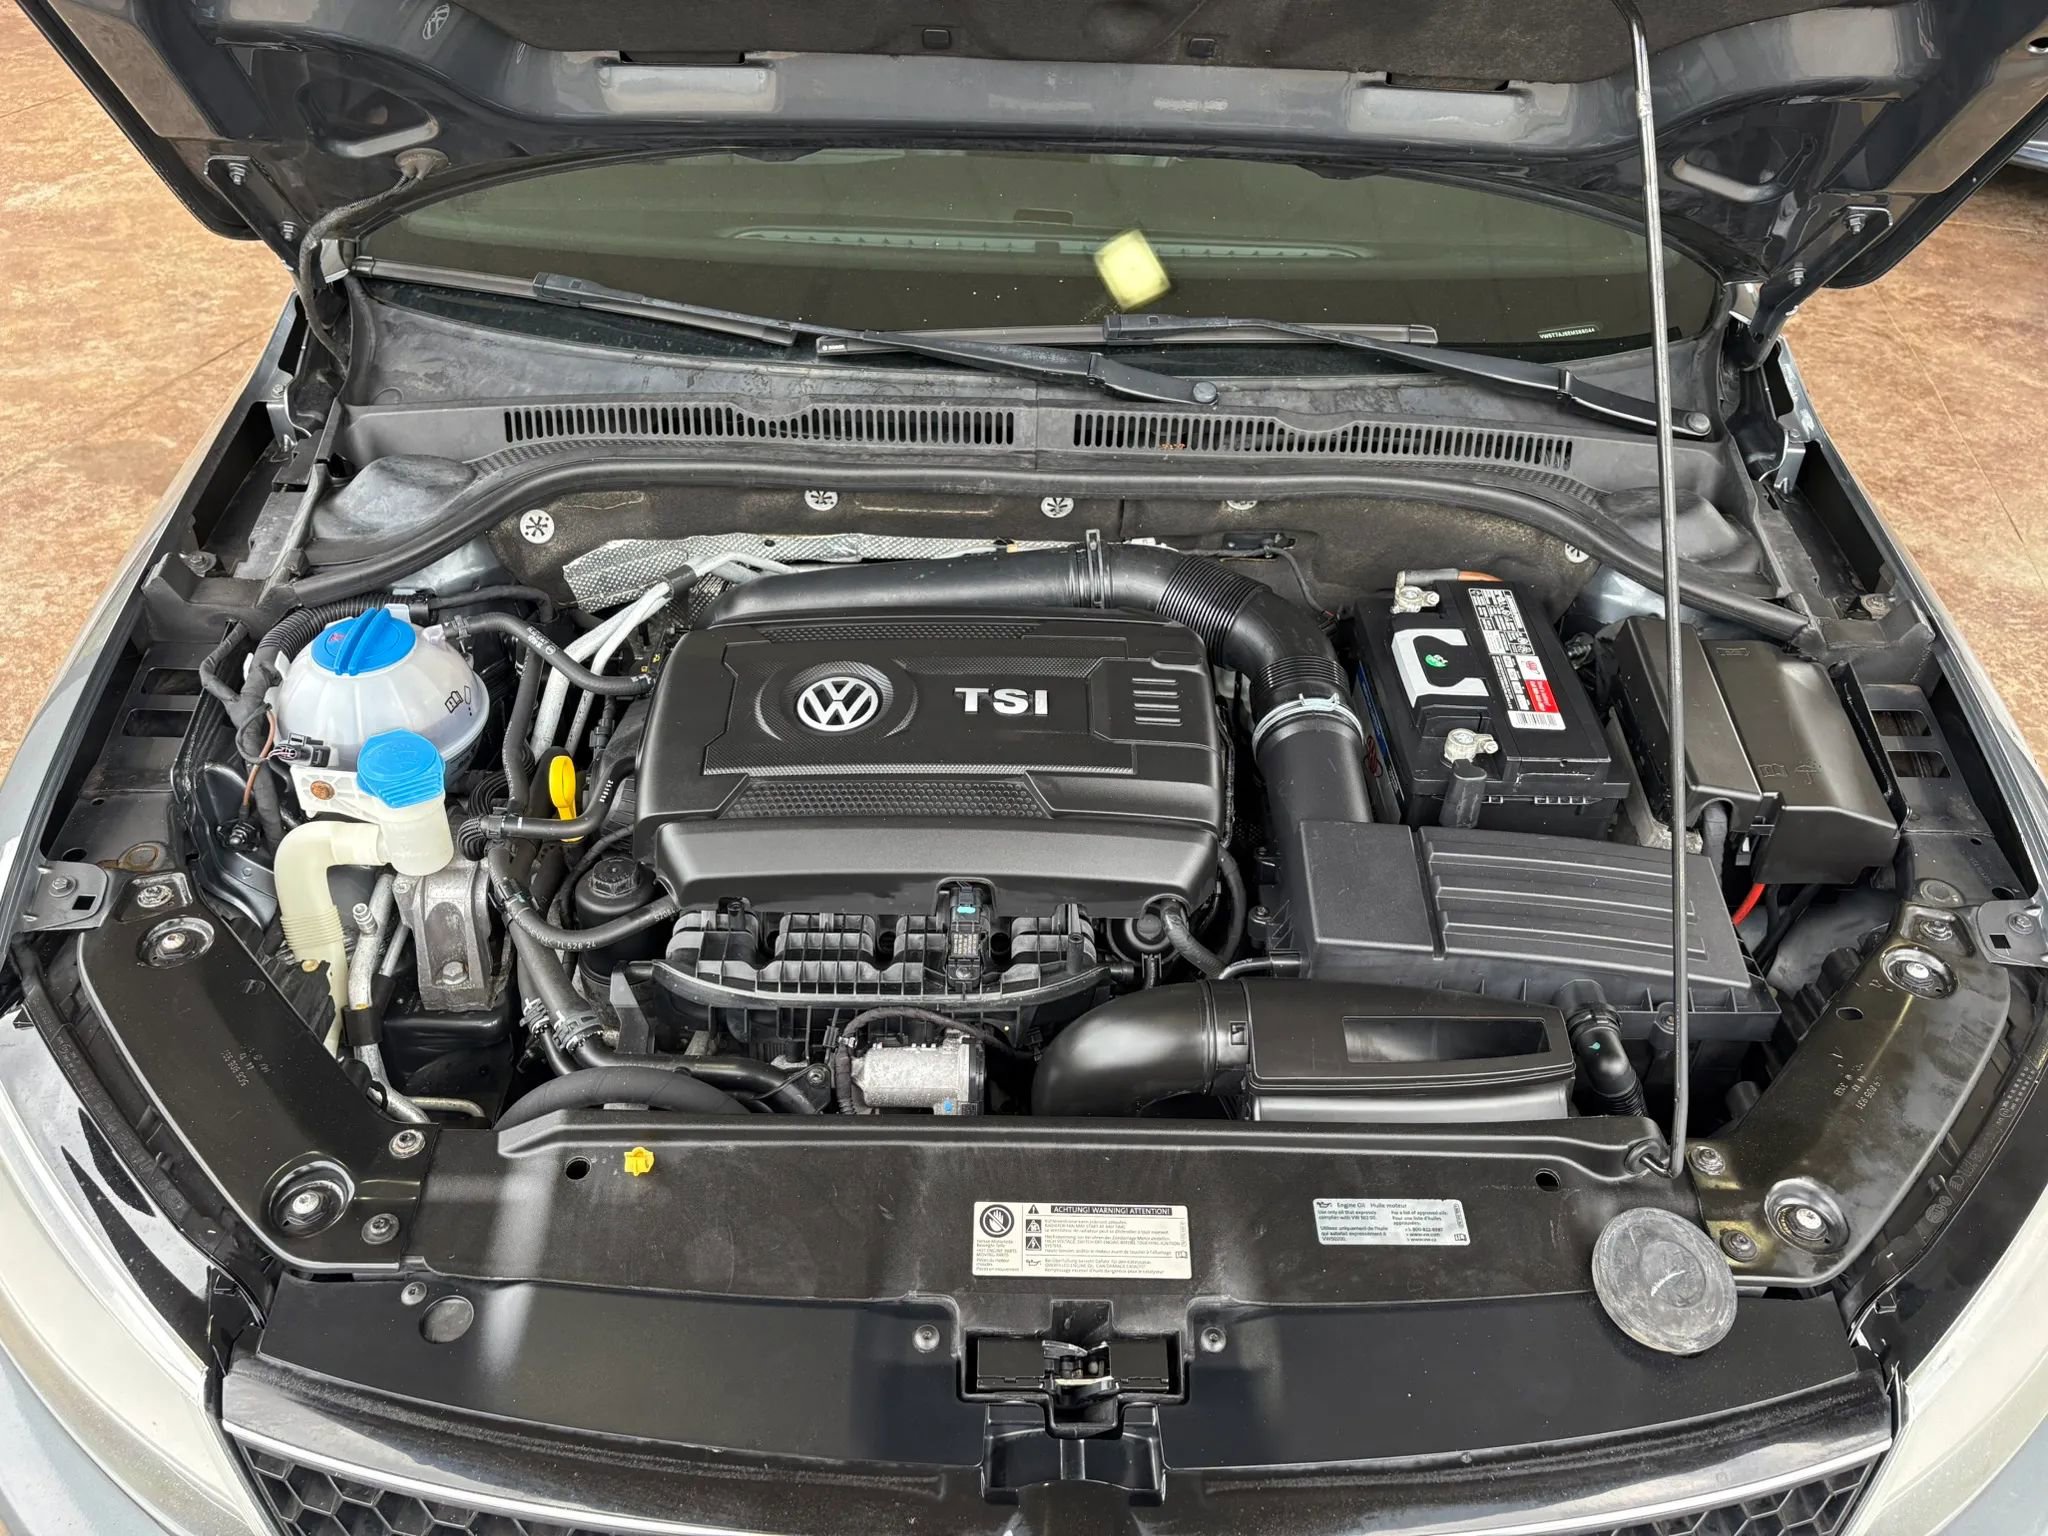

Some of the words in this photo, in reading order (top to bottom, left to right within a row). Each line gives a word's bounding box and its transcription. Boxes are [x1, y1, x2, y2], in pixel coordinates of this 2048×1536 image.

[796, 676, 879, 732] VW
[953, 687, 1049, 716] TSI
[1053, 1206, 1091, 1214] ACHTUNG!
